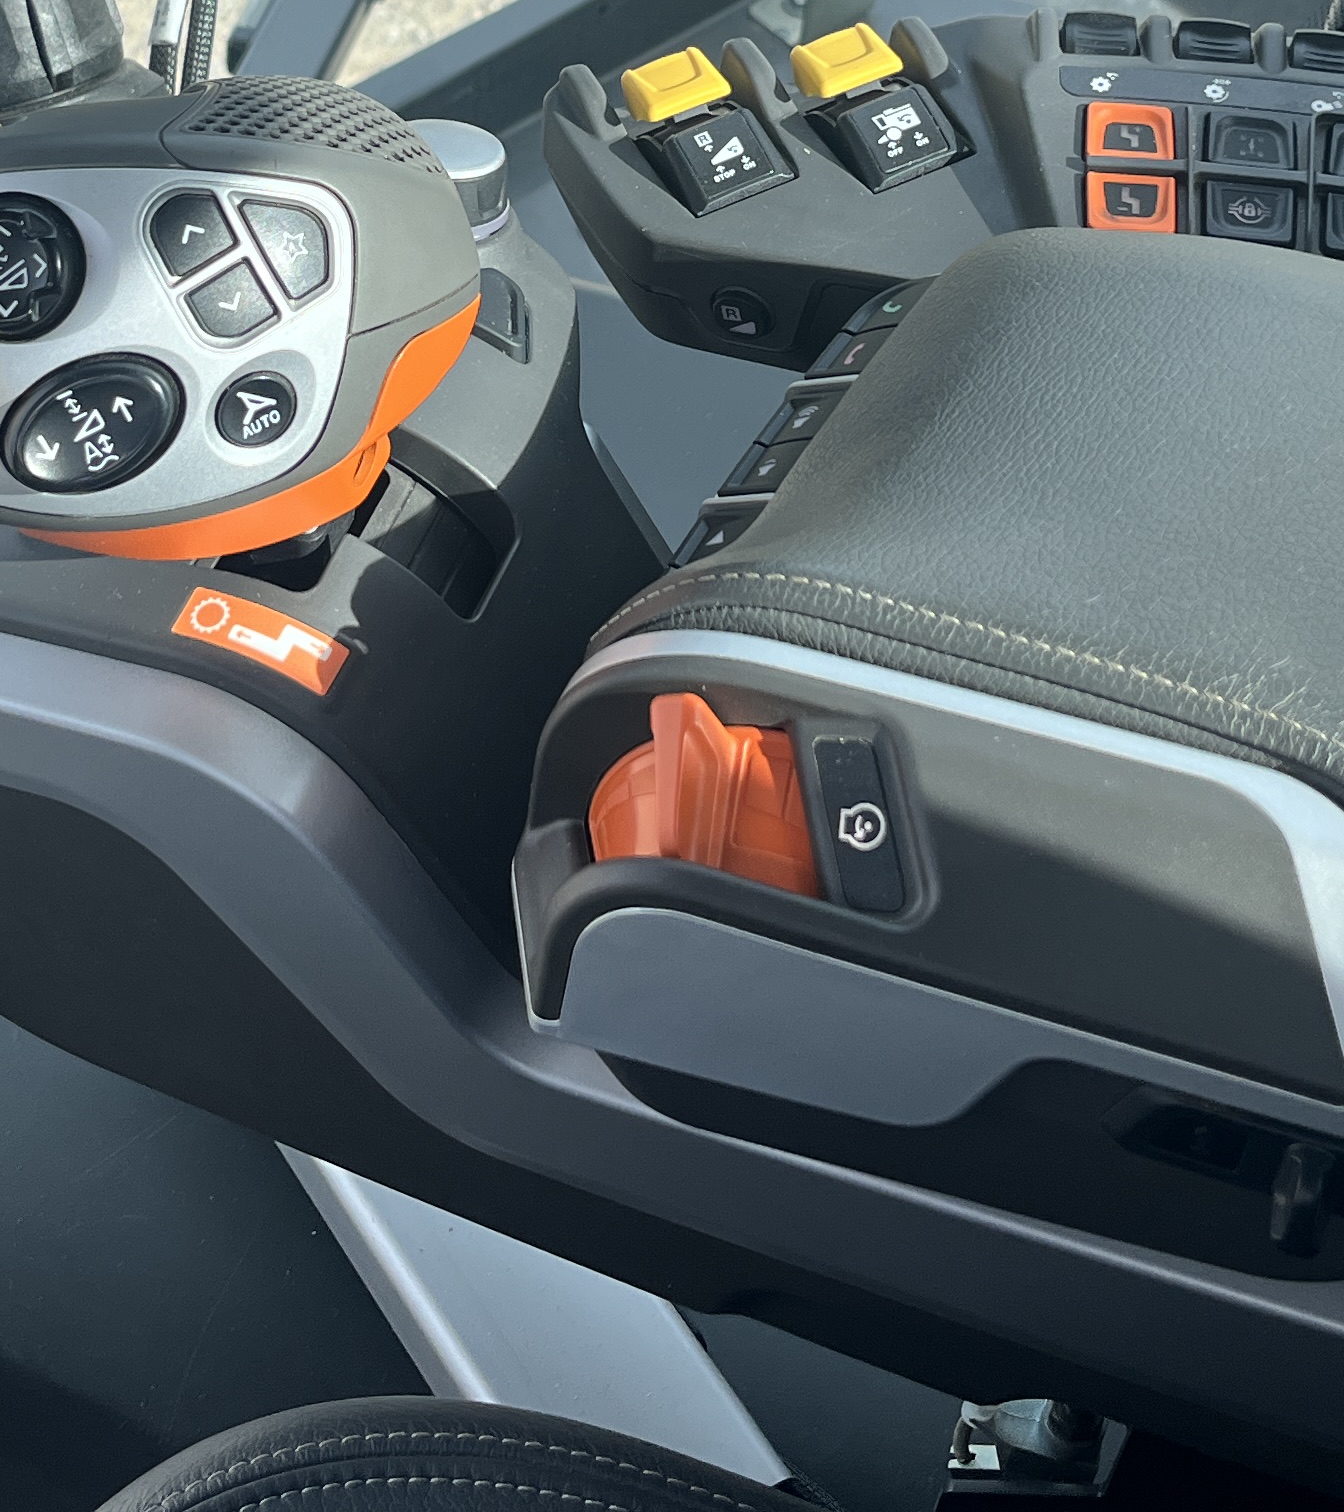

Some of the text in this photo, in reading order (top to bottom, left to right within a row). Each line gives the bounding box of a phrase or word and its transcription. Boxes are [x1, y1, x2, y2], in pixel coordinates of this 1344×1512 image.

[915, 136, 930, 147] ON
[887, 146, 904, 158] OFF
[742, 160, 757, 171] ON
[713, 168, 736, 183] STOP
[243, 411, 281, 440] AUTO
[83, 442, 102, 465] A
